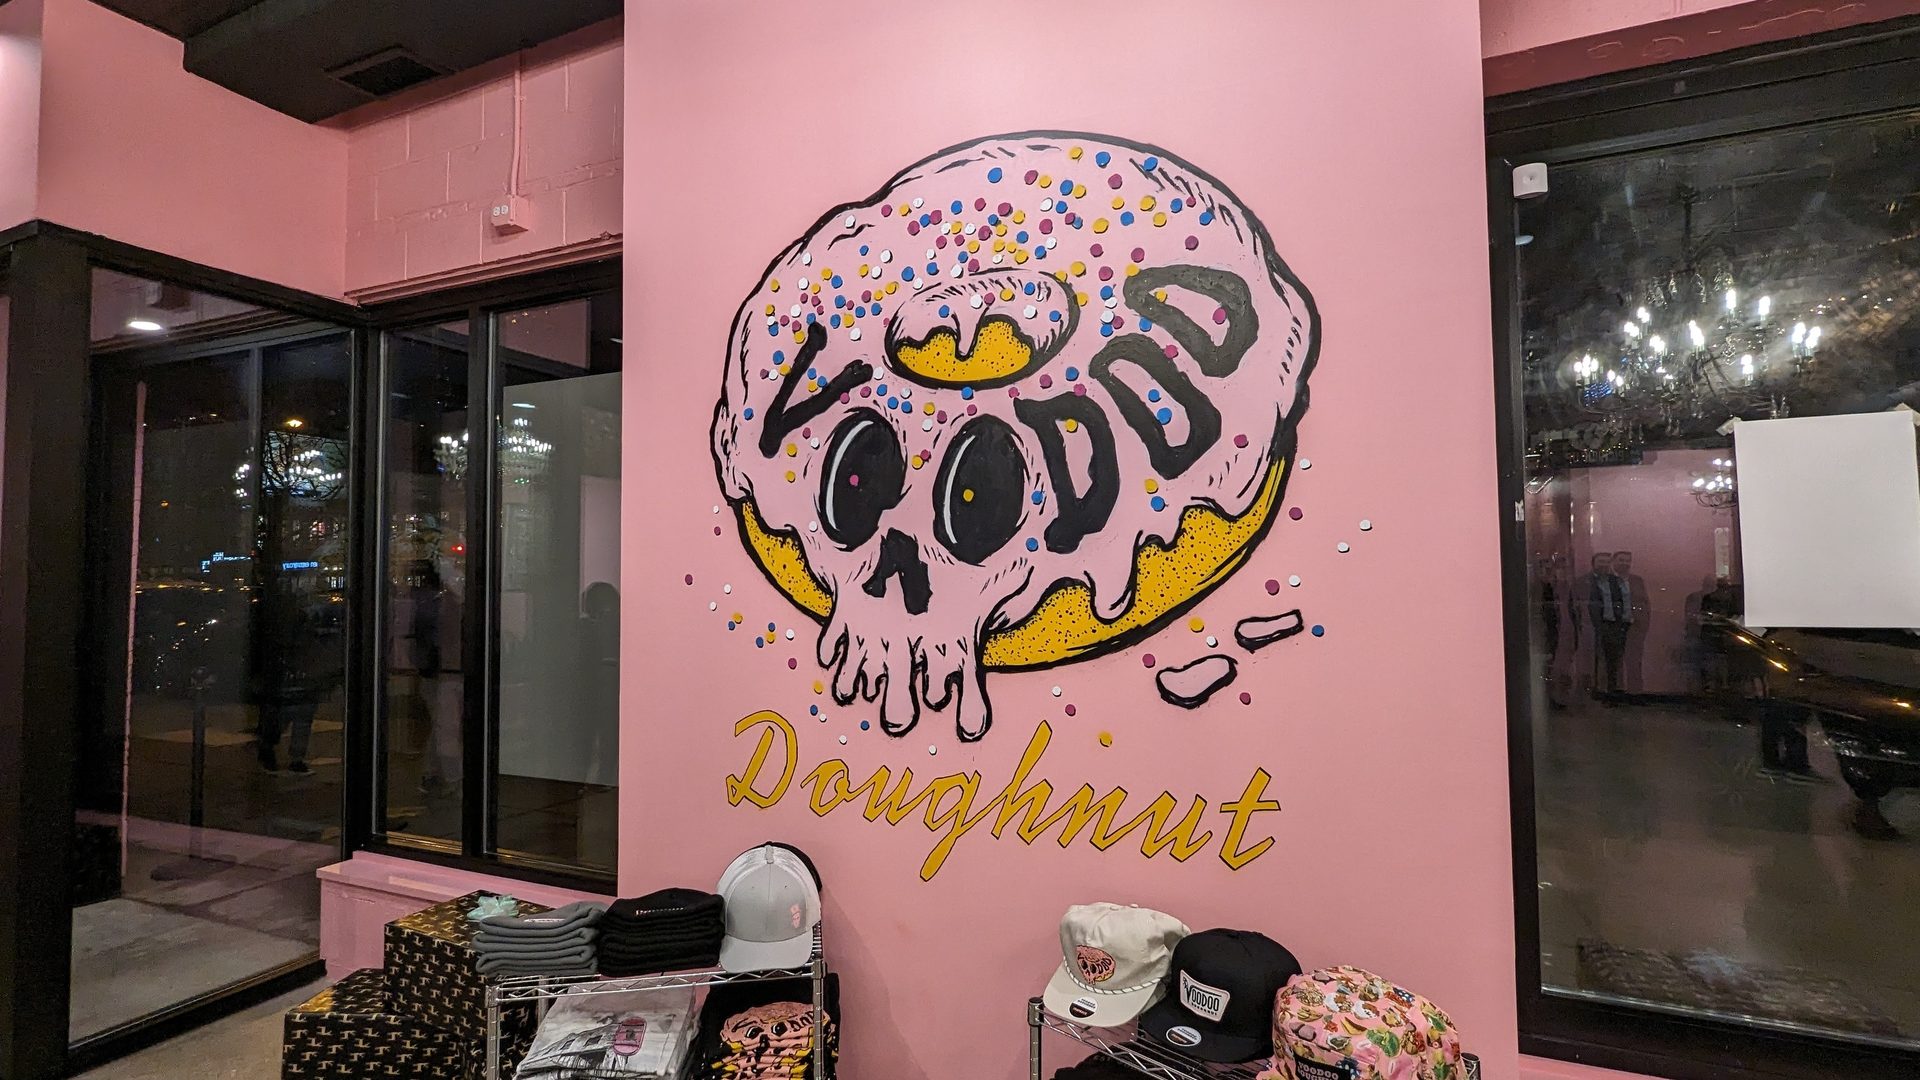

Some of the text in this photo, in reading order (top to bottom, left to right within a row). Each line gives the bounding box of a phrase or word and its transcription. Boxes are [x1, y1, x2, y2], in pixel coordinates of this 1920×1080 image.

[758, 263, 1260, 567] VOODOO
[725, 709, 1282, 882] Doughnut
[1183, 977, 1222, 1012] VOODOO
[1298, 1061, 1339, 1080] VOODOO
